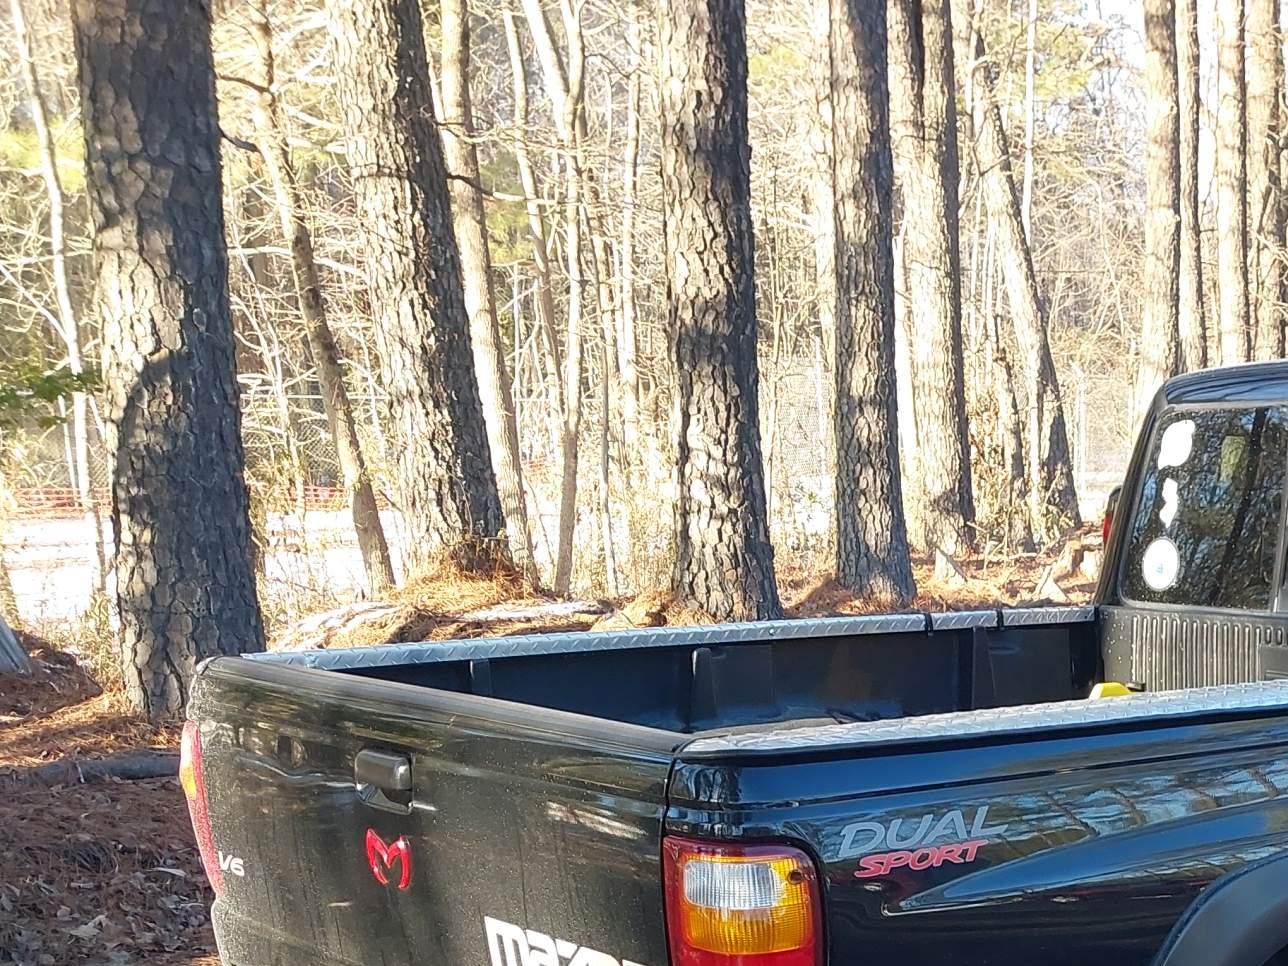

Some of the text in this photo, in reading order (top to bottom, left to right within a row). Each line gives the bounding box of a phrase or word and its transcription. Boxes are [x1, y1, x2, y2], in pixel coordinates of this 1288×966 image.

[838, 805, 1008, 858] DUAL
[218, 851, 245, 877] V6
[854, 839, 989, 878] SPORT
